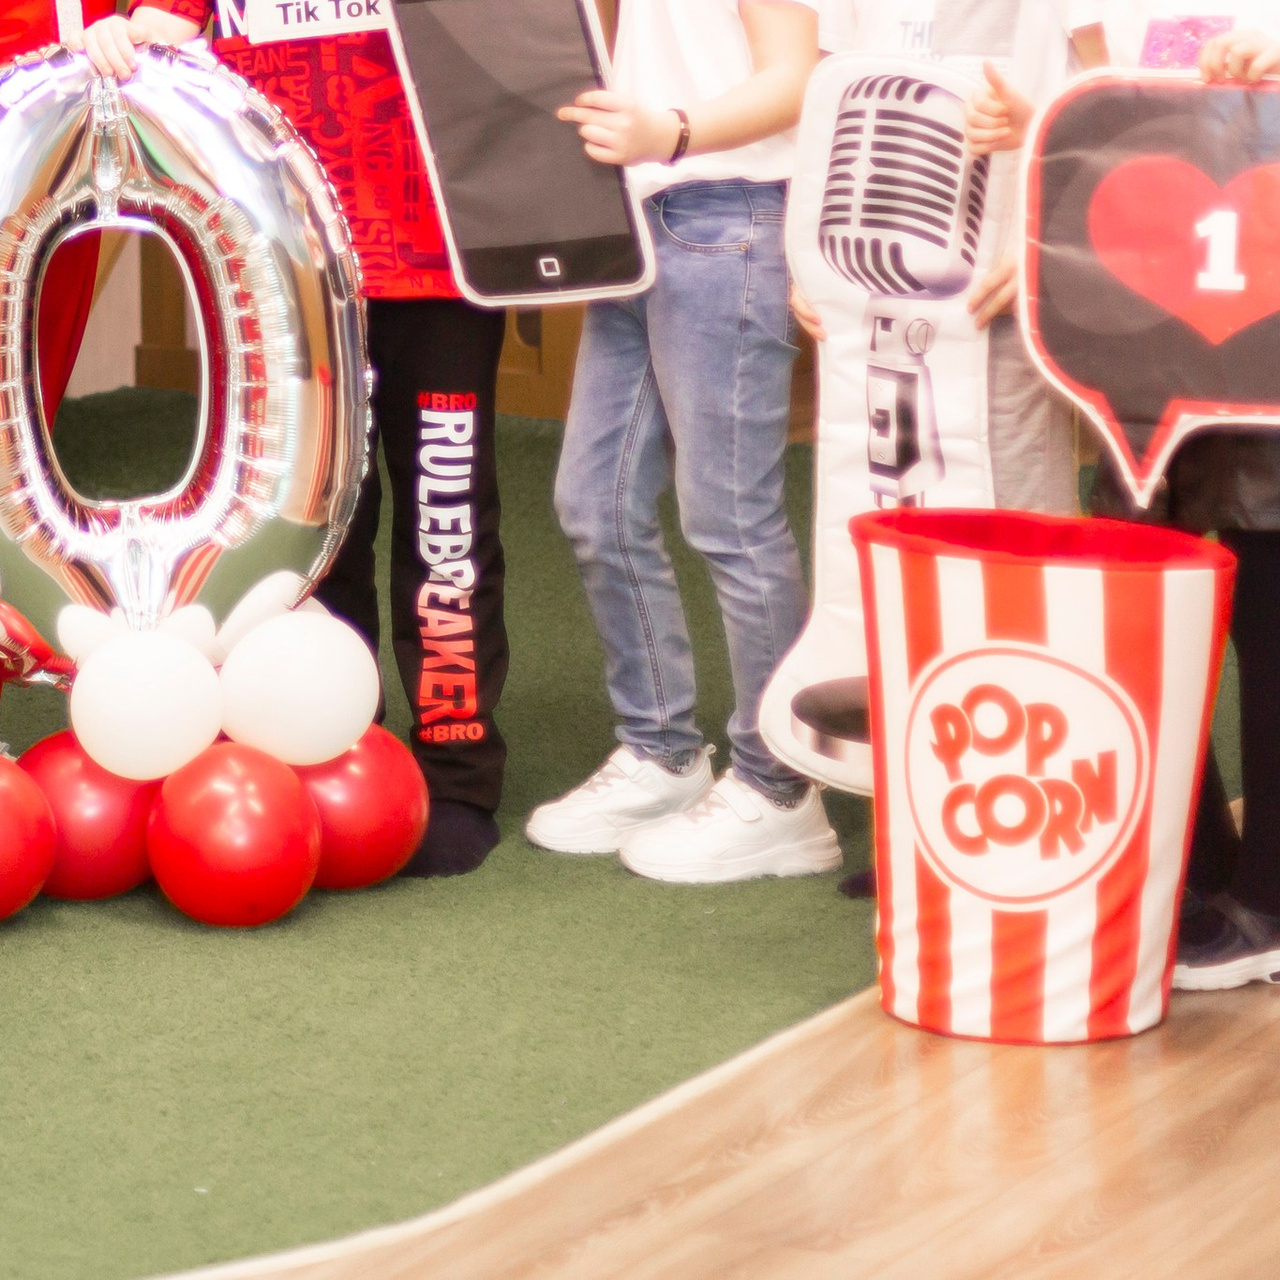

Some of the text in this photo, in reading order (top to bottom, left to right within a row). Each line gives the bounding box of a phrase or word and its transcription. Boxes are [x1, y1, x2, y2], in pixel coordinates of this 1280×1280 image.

[1195, 209, 1246, 292] 1
[417, 391, 477, 412] #BRO
[417, 410, 478, 726] RULEBREAKER
[419, 722, 485, 743] #BRO
[928, 683, 1069, 784] POP
[940, 749, 1118, 861] CORN
